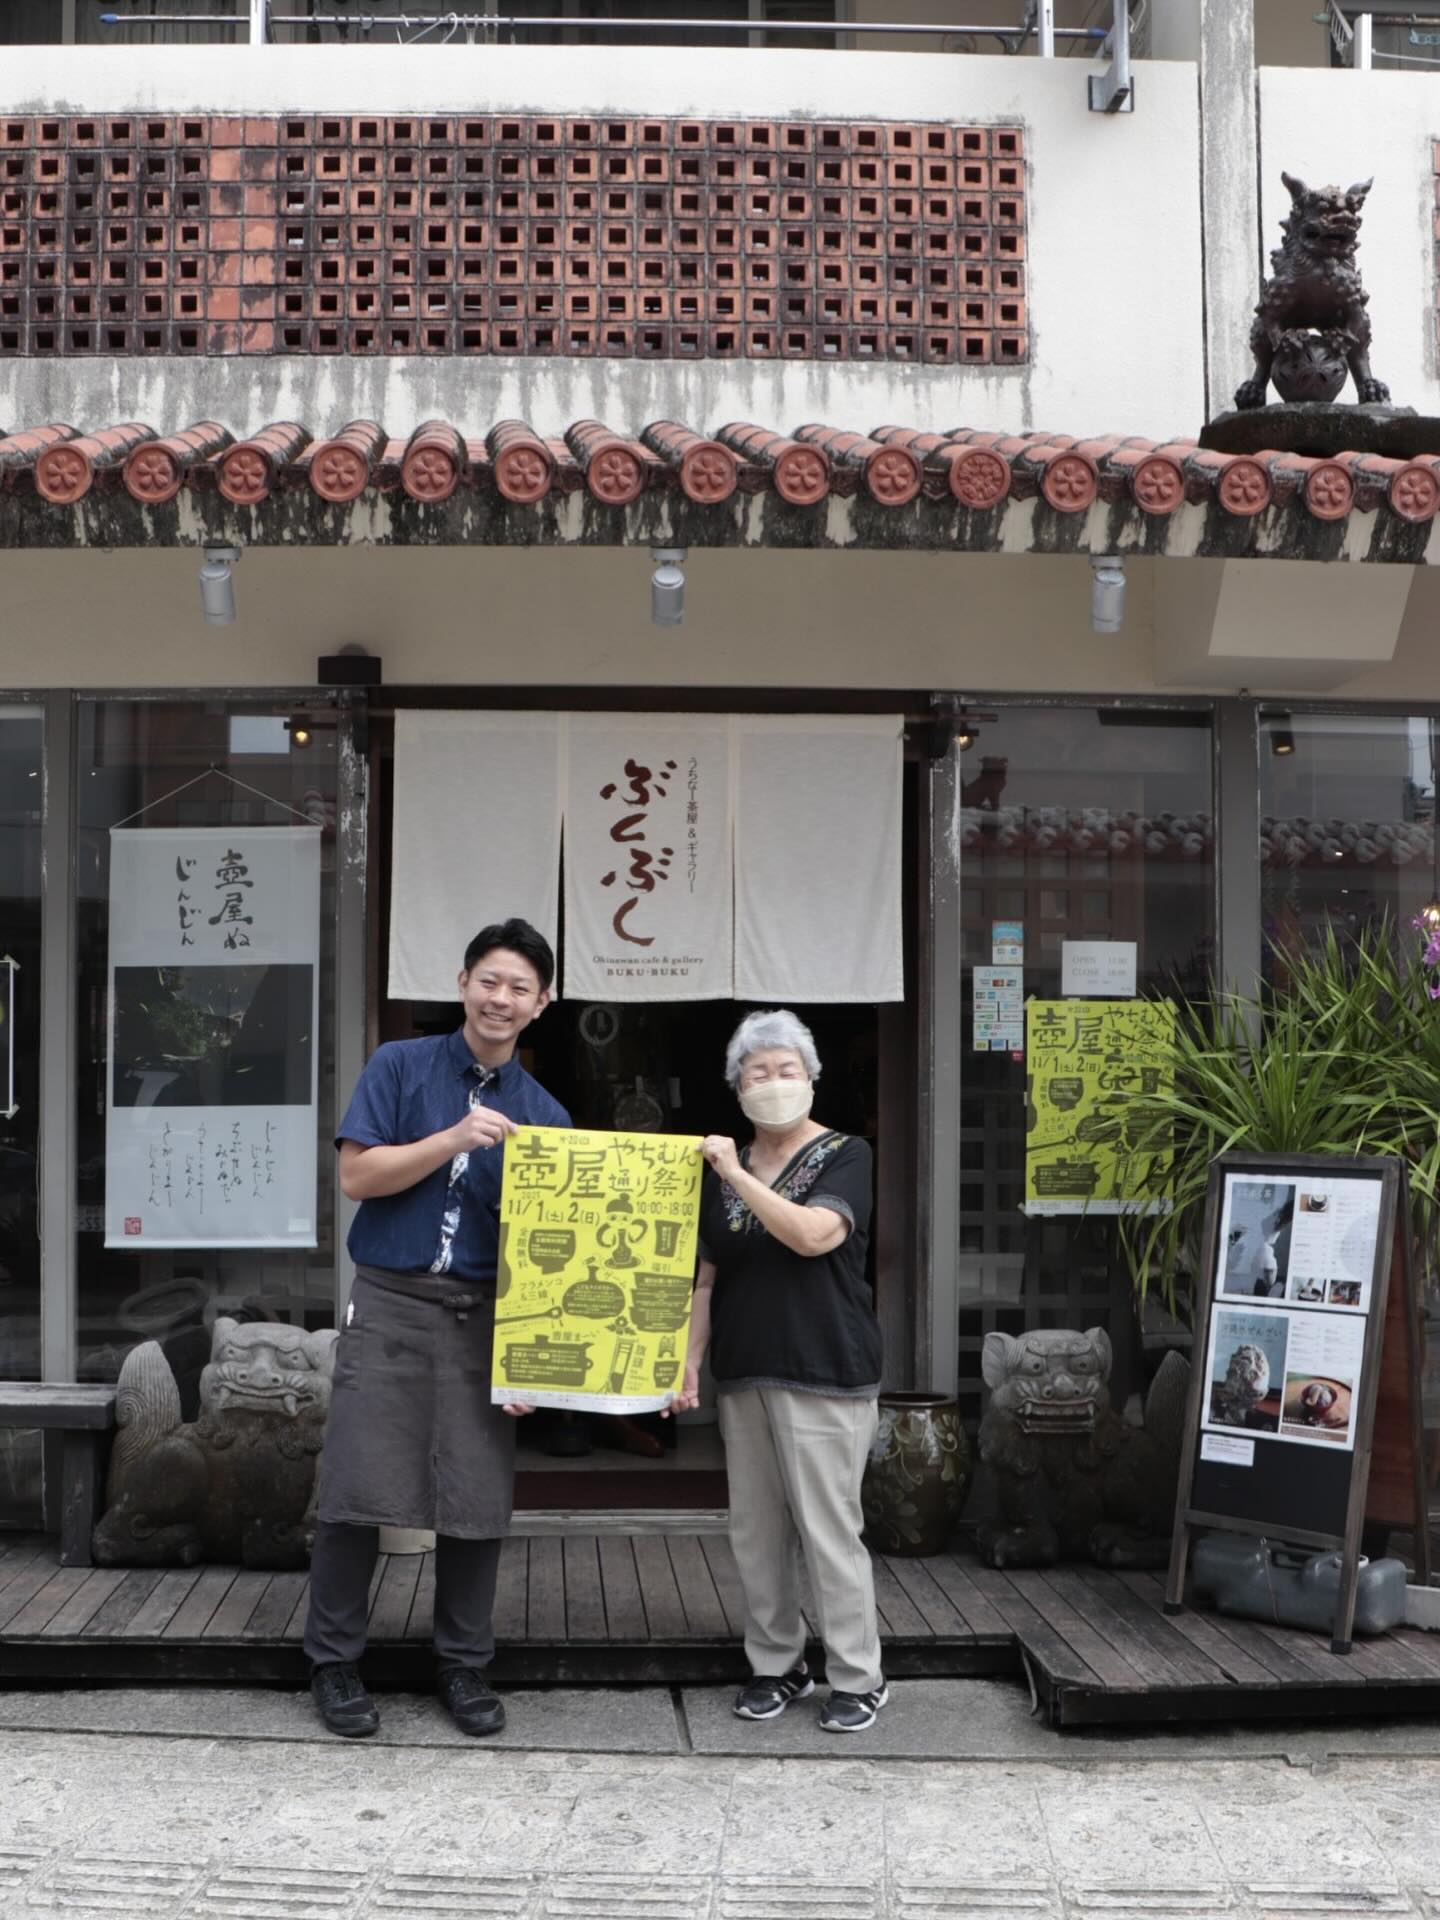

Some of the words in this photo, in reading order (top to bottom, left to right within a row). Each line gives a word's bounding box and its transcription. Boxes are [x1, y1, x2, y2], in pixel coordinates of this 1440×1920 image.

[1032, 1007, 1104, 1055] 壺屋
[510, 1134, 607, 1199] 壺屋
[608, 1136, 698, 1170] やちむん
[608, 1167, 698, 1198] 通り祭り
